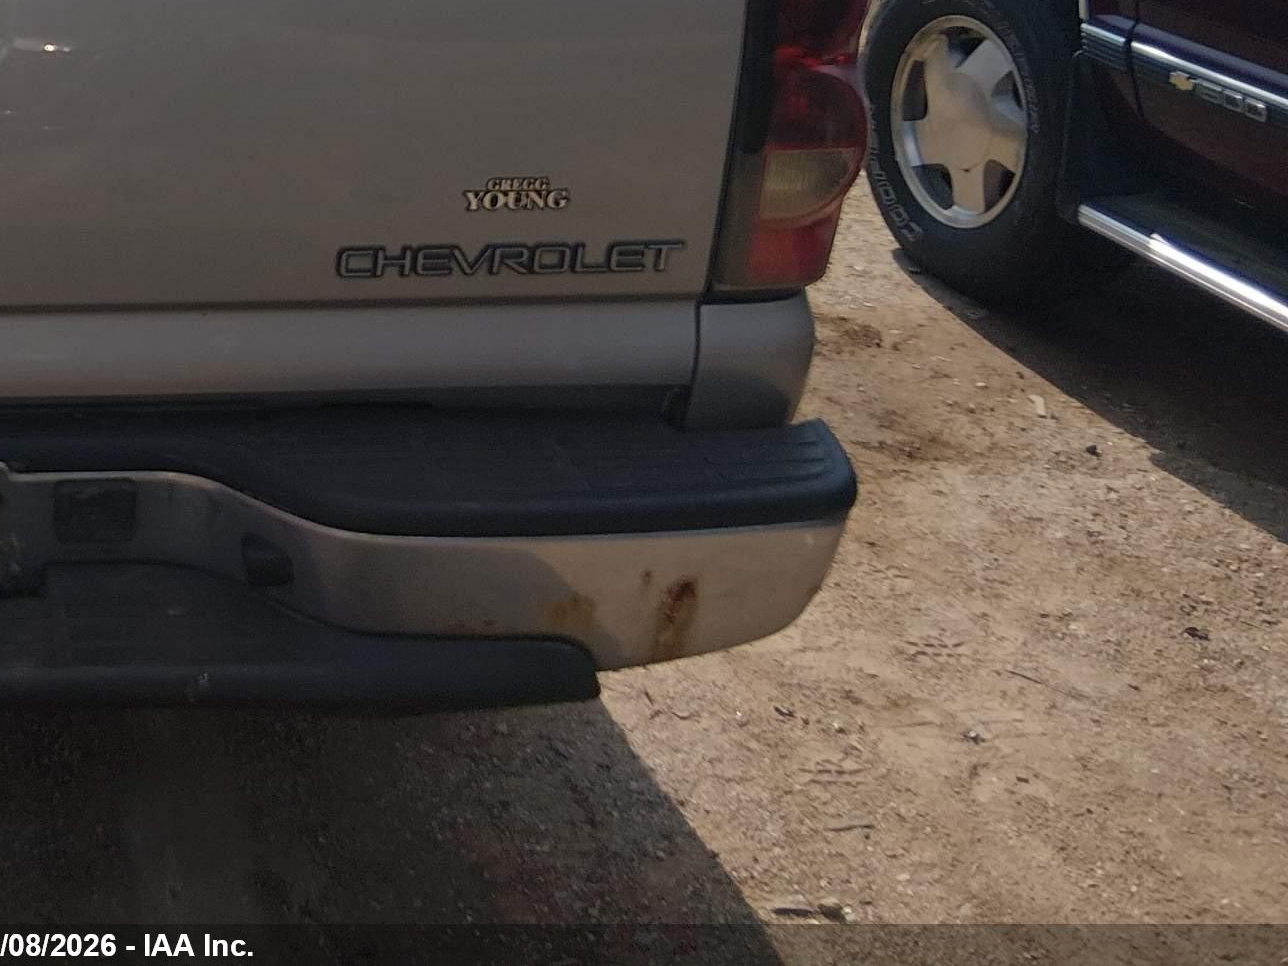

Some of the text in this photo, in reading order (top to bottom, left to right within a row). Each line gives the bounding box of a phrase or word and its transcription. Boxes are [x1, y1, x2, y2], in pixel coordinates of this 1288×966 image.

[486, 176, 550, 191] GREGG
[463, 188, 570, 212] YOUNG
[337, 240, 685, 278] CHEVROLET
